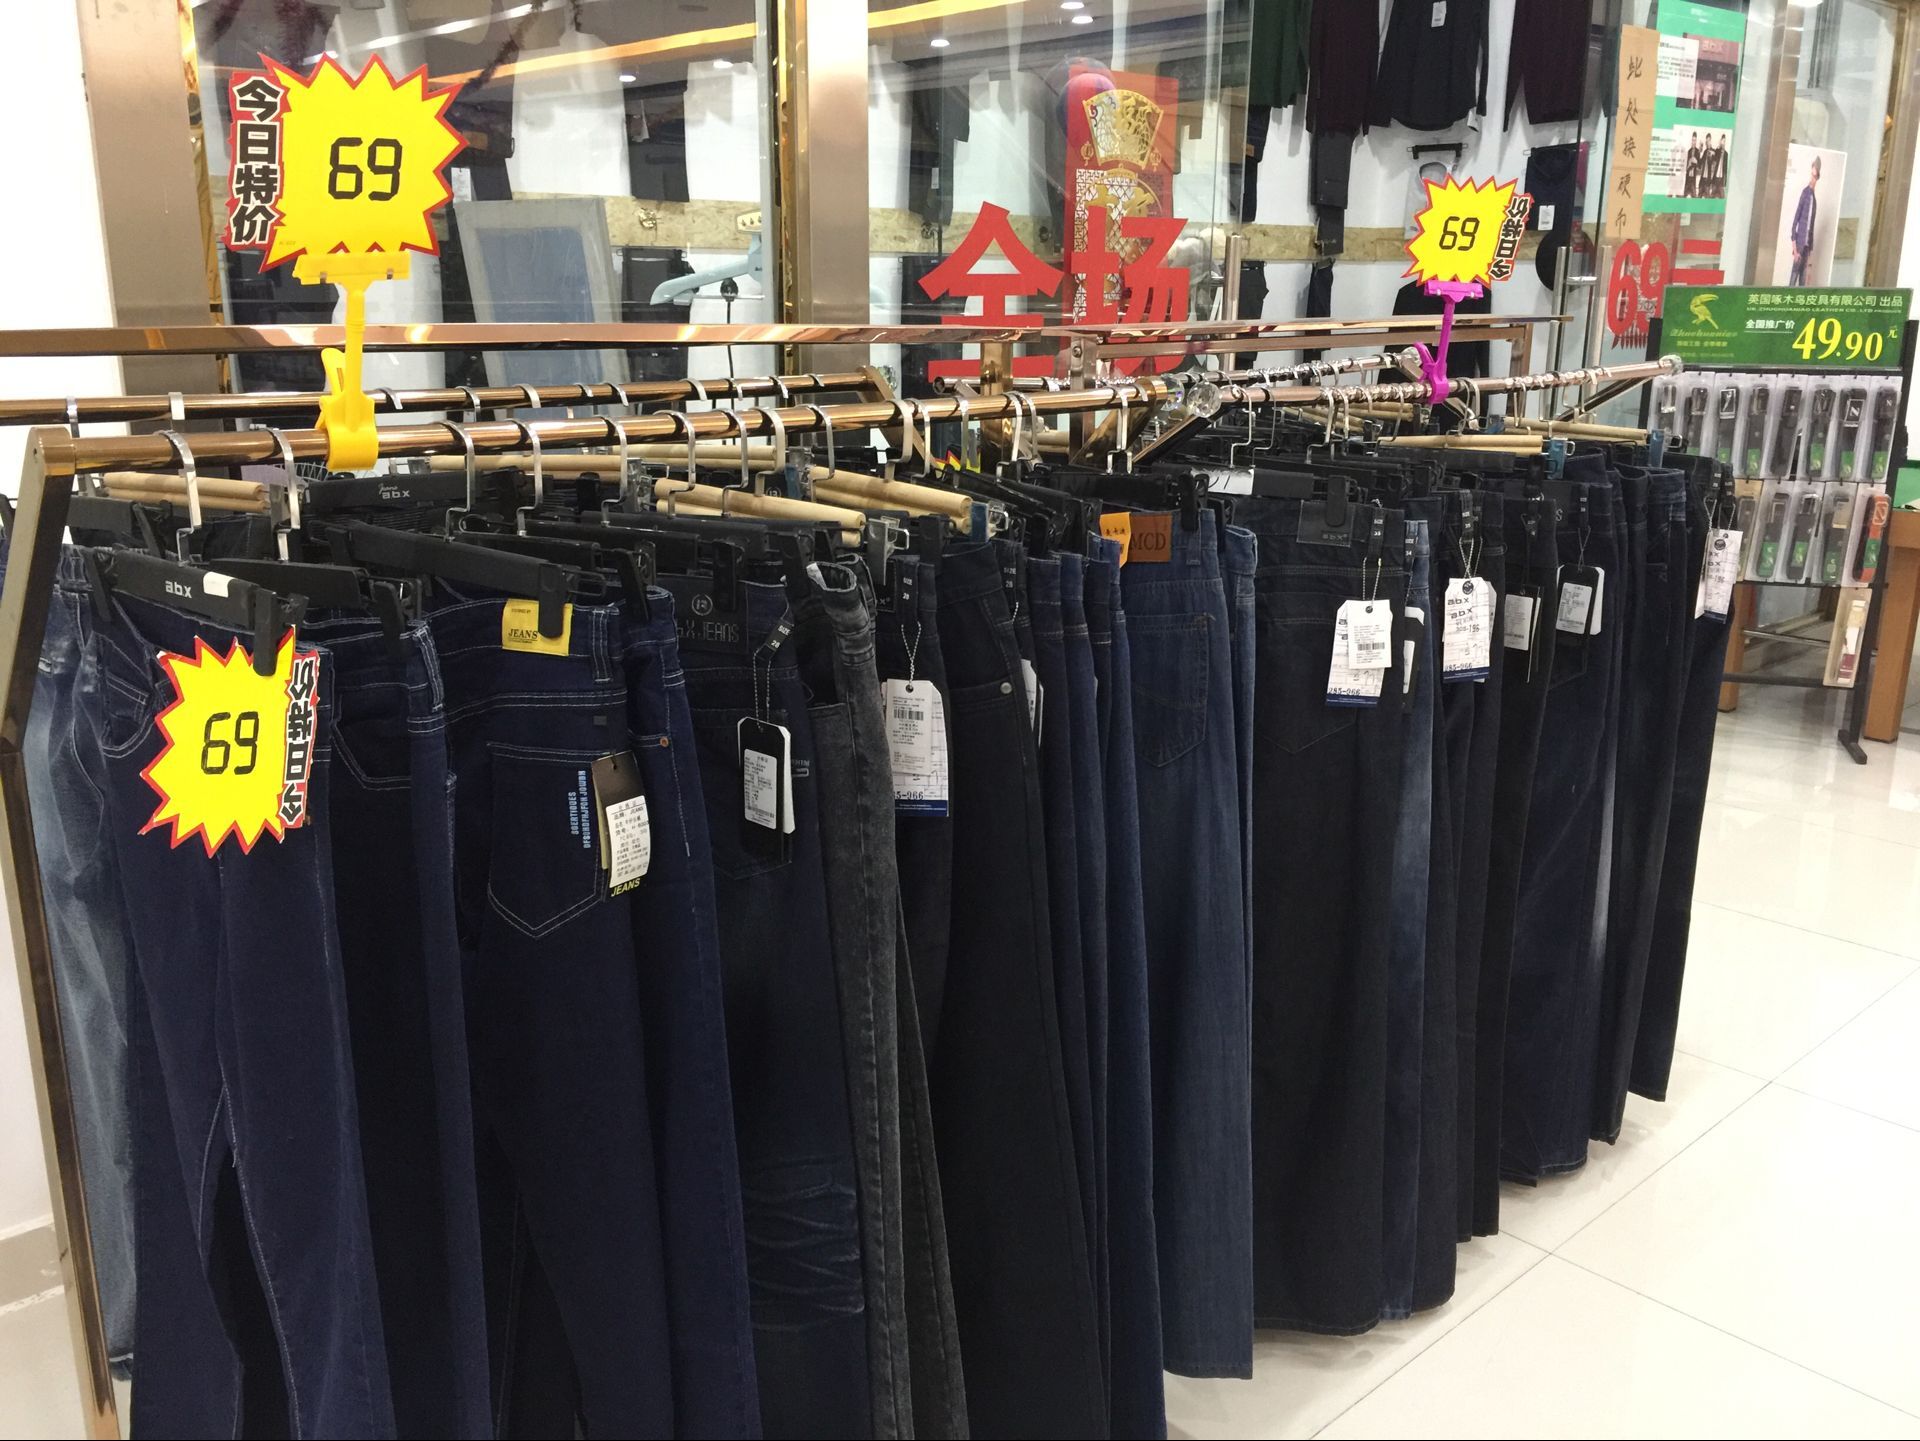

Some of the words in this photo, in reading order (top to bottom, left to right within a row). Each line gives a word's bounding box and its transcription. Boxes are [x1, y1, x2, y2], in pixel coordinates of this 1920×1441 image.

[232, 79, 282, 243] 今日特价
[328, 137, 402, 201] 69
[1439, 216, 1480, 251] 69
[918, 201, 1190, 383] 全场
[1879, 296, 1903, 307] 出品
[1745, 319, 1795, 329] 全国推广价
[1792, 318, 1883, 361] 49.90
[165, 580, 192, 598] abx
[1447, 597, 1470, 606] abx
[1451, 608, 1473, 619] abx
[508, 628, 539, 639] JEANS
[201, 711, 259, 775] 69
[281, 660, 314, 823] 今日特价
[611, 878, 641, 897] JEANS
